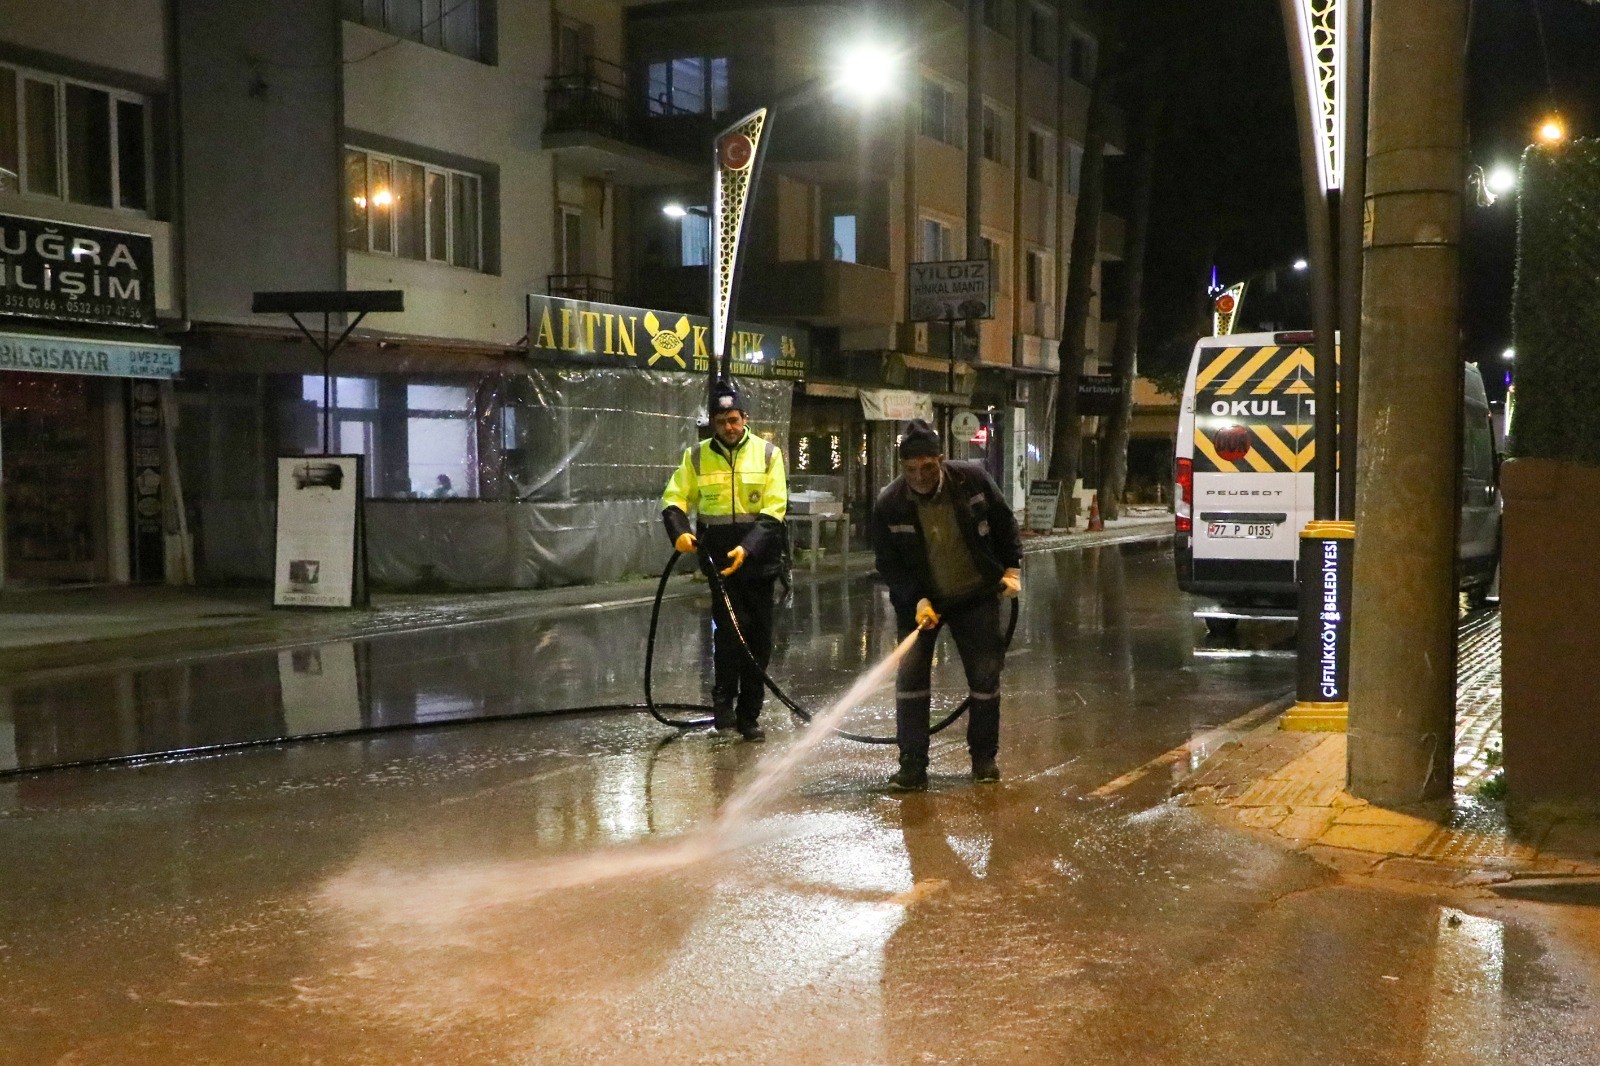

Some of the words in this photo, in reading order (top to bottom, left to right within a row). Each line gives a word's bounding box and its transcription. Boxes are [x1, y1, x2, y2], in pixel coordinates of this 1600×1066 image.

[0, 226, 138, 271] UĞRA
[5, 295, 24, 307] 352
[28, 297, 41, 309] 00
[43, 299, 56, 311] 66
[66, 301, 91, 314] 0532
[536, 305, 637, 356] ALTIN
[692, 325, 765, 363] KEK
[694, 358, 710, 372] PİD
[1211, 400, 1286, 416] OKUL
[1214, 525, 1226, 535] 77
[1234, 525, 1240, 535] P
[1248, 525, 1270, 536] 0135
[1322, 541, 1337, 611] BELEDİYESİ
[1321, 622, 1338, 697] ÇİFTLİKKÖY
